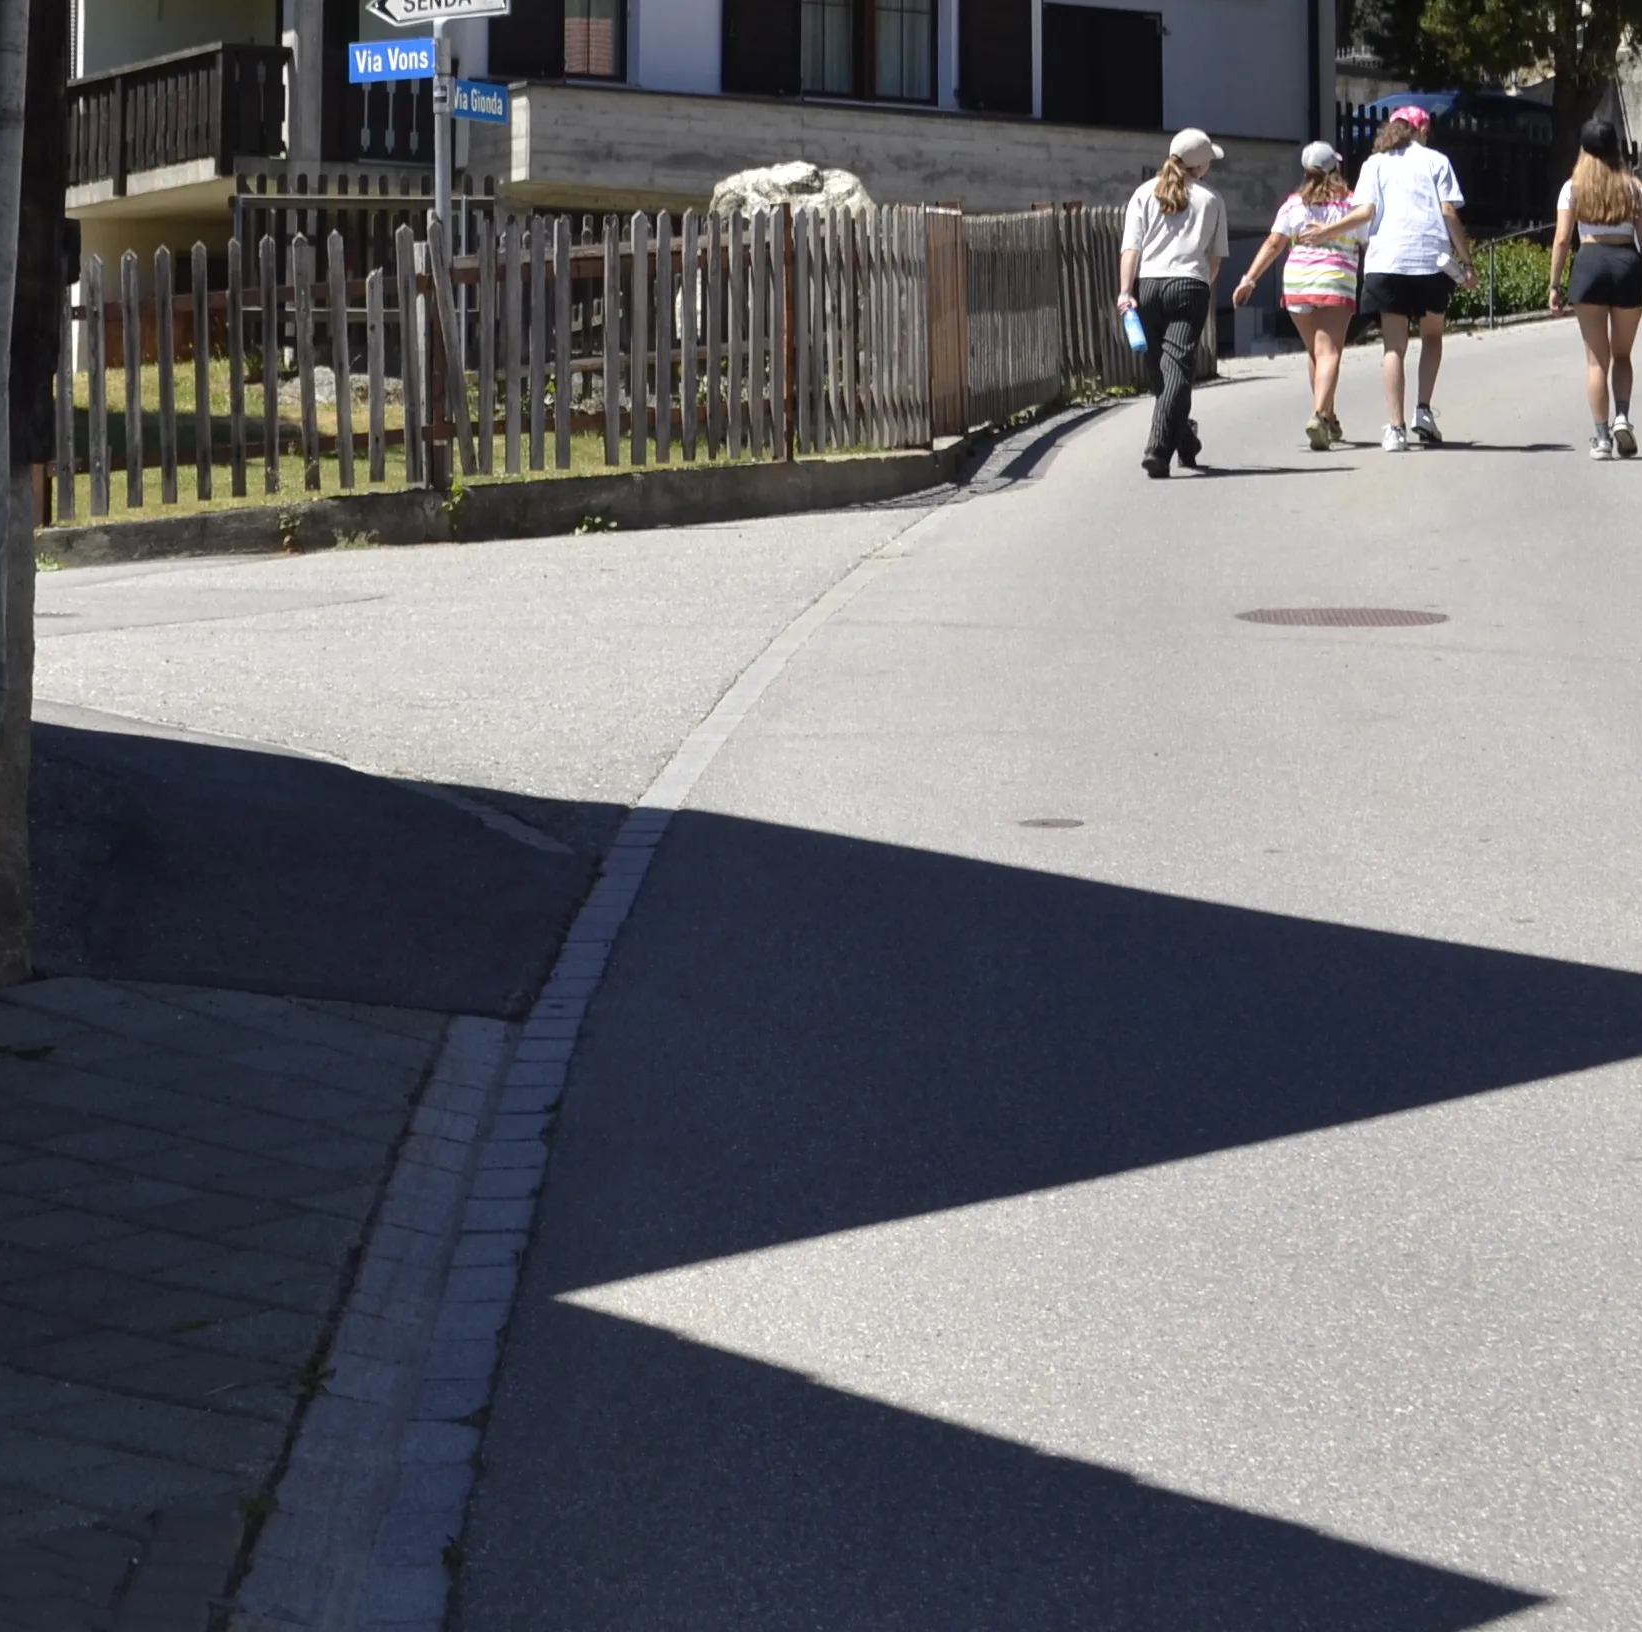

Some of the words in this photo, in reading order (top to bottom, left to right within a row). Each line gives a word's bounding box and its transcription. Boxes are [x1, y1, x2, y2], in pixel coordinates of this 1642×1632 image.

[355, 50, 382, 74] Via
[387, 46, 429, 70] Vons
[470, 87, 503, 116] Gionda
